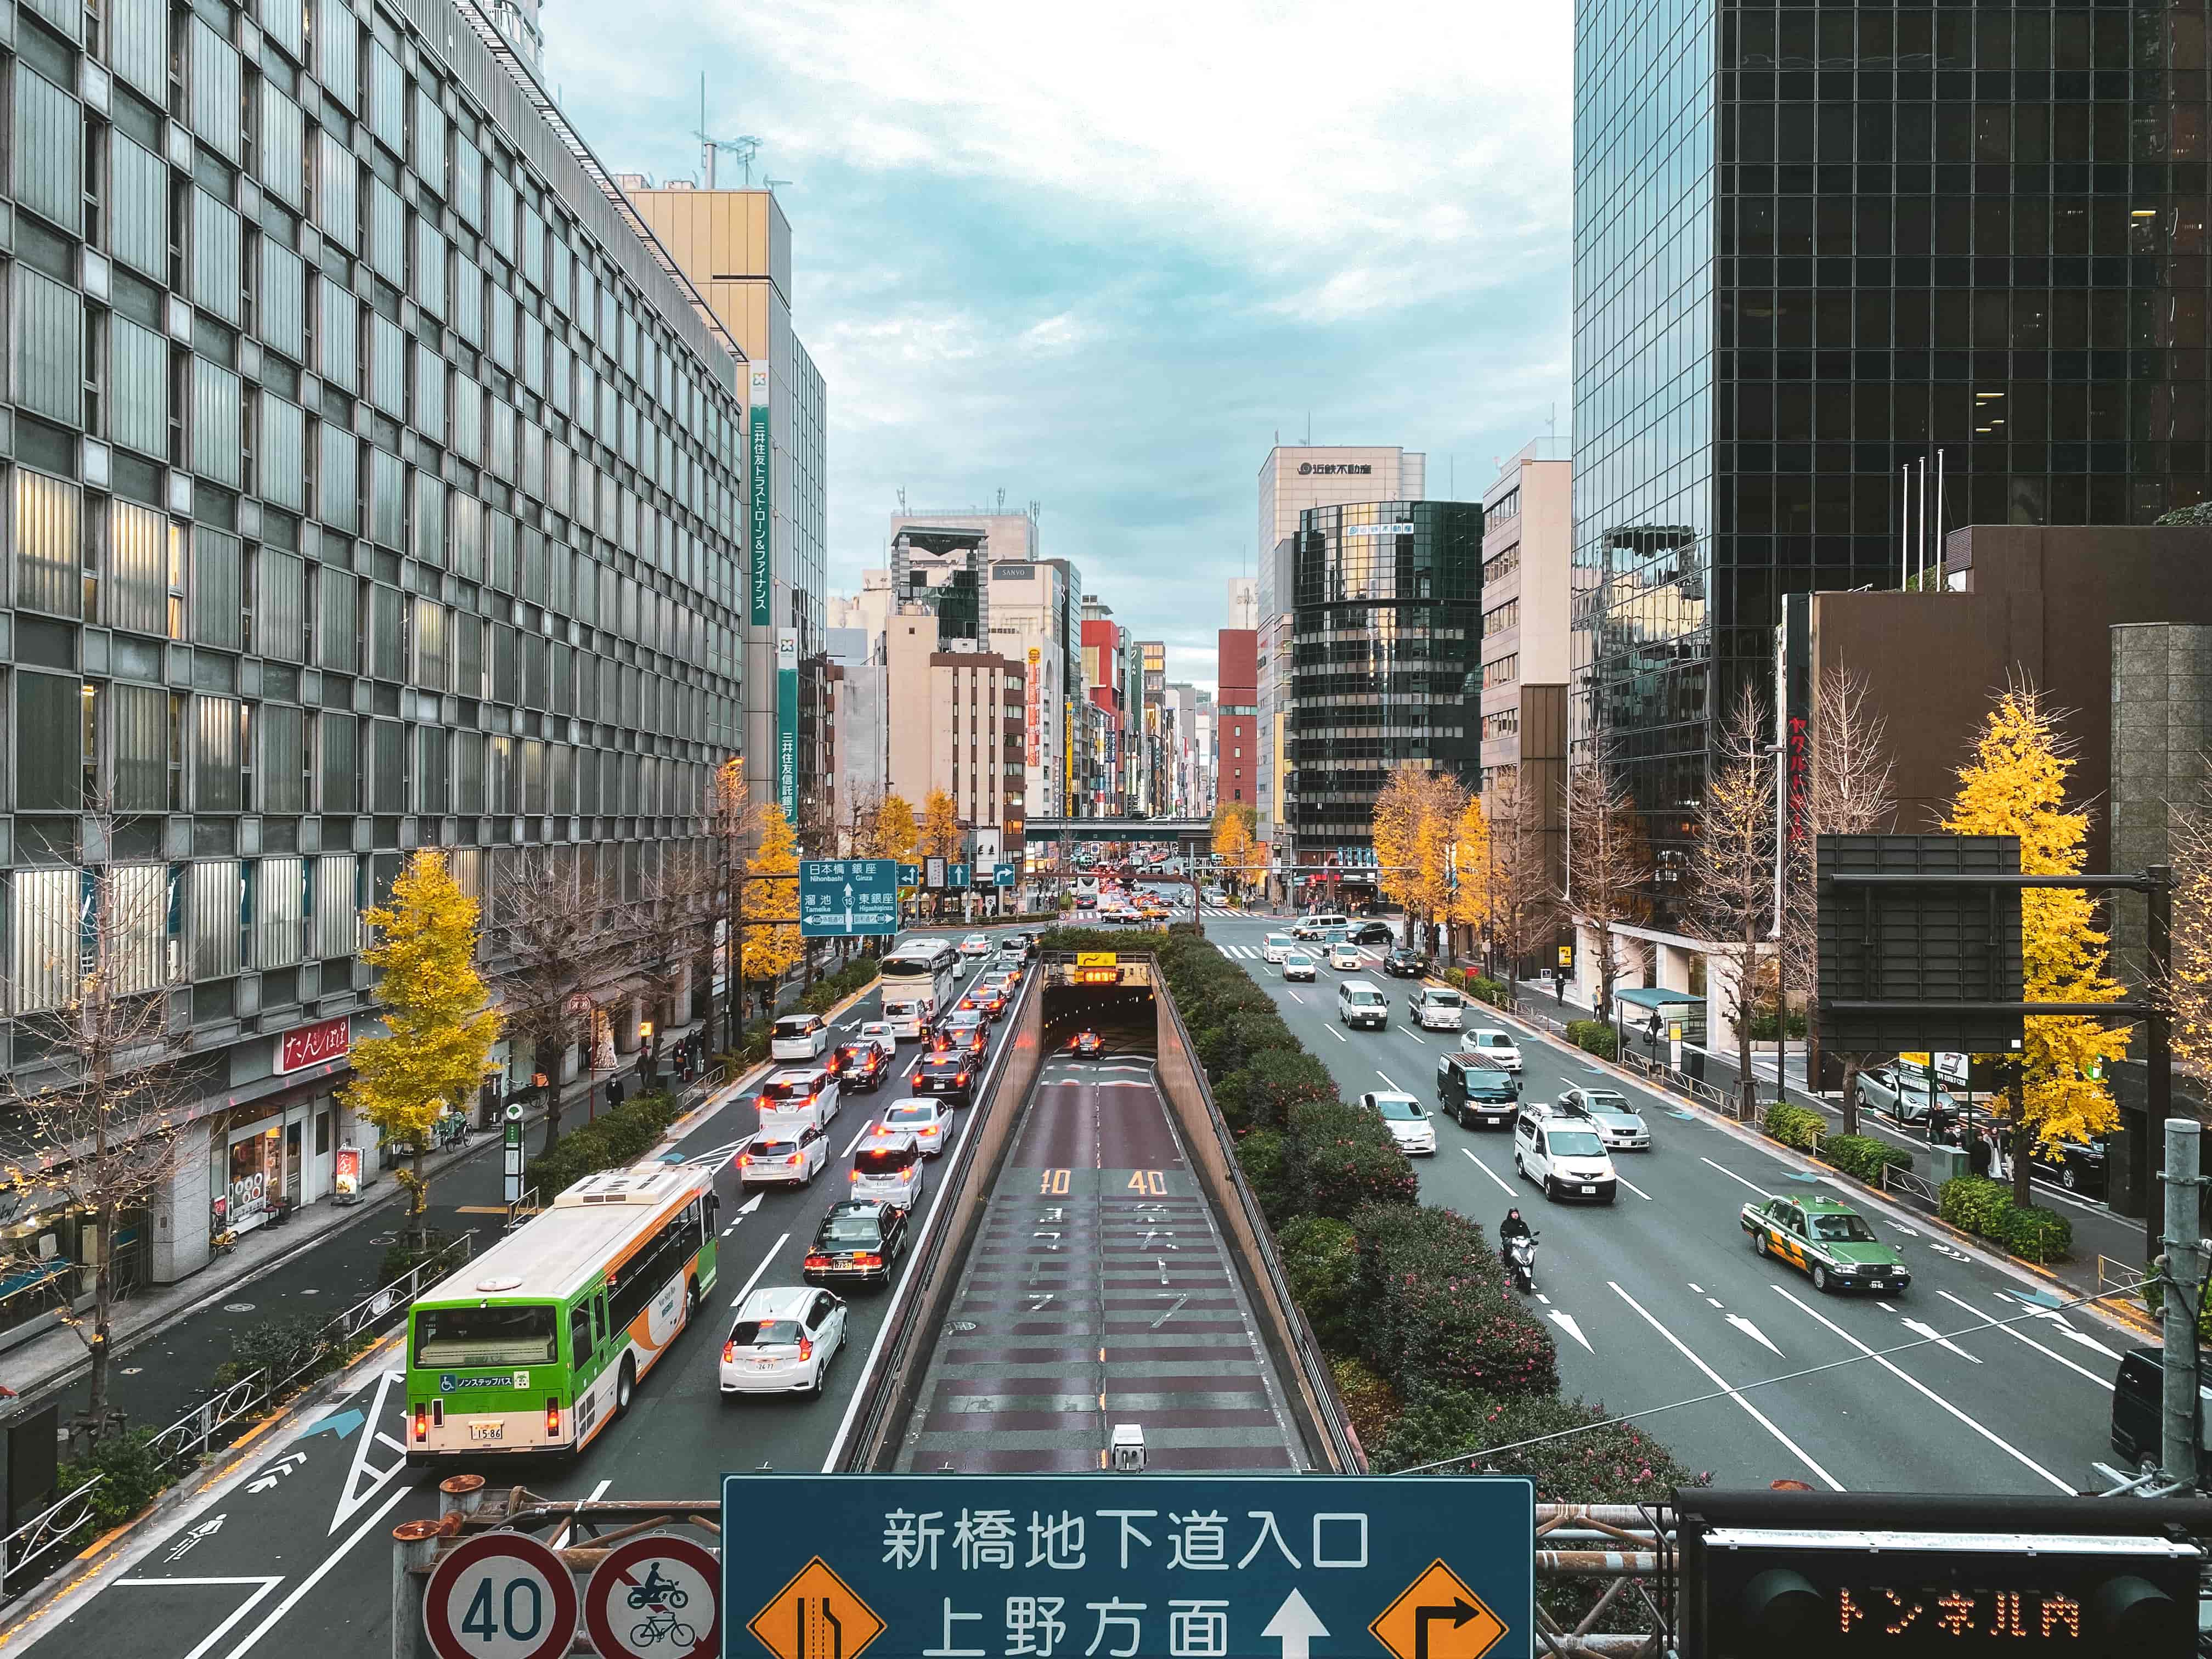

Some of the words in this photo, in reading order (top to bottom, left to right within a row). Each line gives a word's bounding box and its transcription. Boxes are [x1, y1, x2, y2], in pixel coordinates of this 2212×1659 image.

[1313, 464, 1372, 475] 近鉄不動産
[781, 733, 793, 818] 三井住友信託銀行
[810, 864, 844, 875] 日本橋
[851, 863, 877, 874] 銀座
[805, 894, 831, 905] 溜池
[859, 893, 894, 905] 東銀座
[286, 1022, 346, 1064] たんぽぽ
[1127, 1171, 1167, 1195] 40
[459, 1378, 512, 1387] ノンステップバス
[882, 1508, 1368, 1570] 新橋地下道入口
[461, 1578, 541, 1641] 40
[1840, 1587, 2080, 1638] トンネル内
[922, 1596, 1229, 1657] 上野方面
